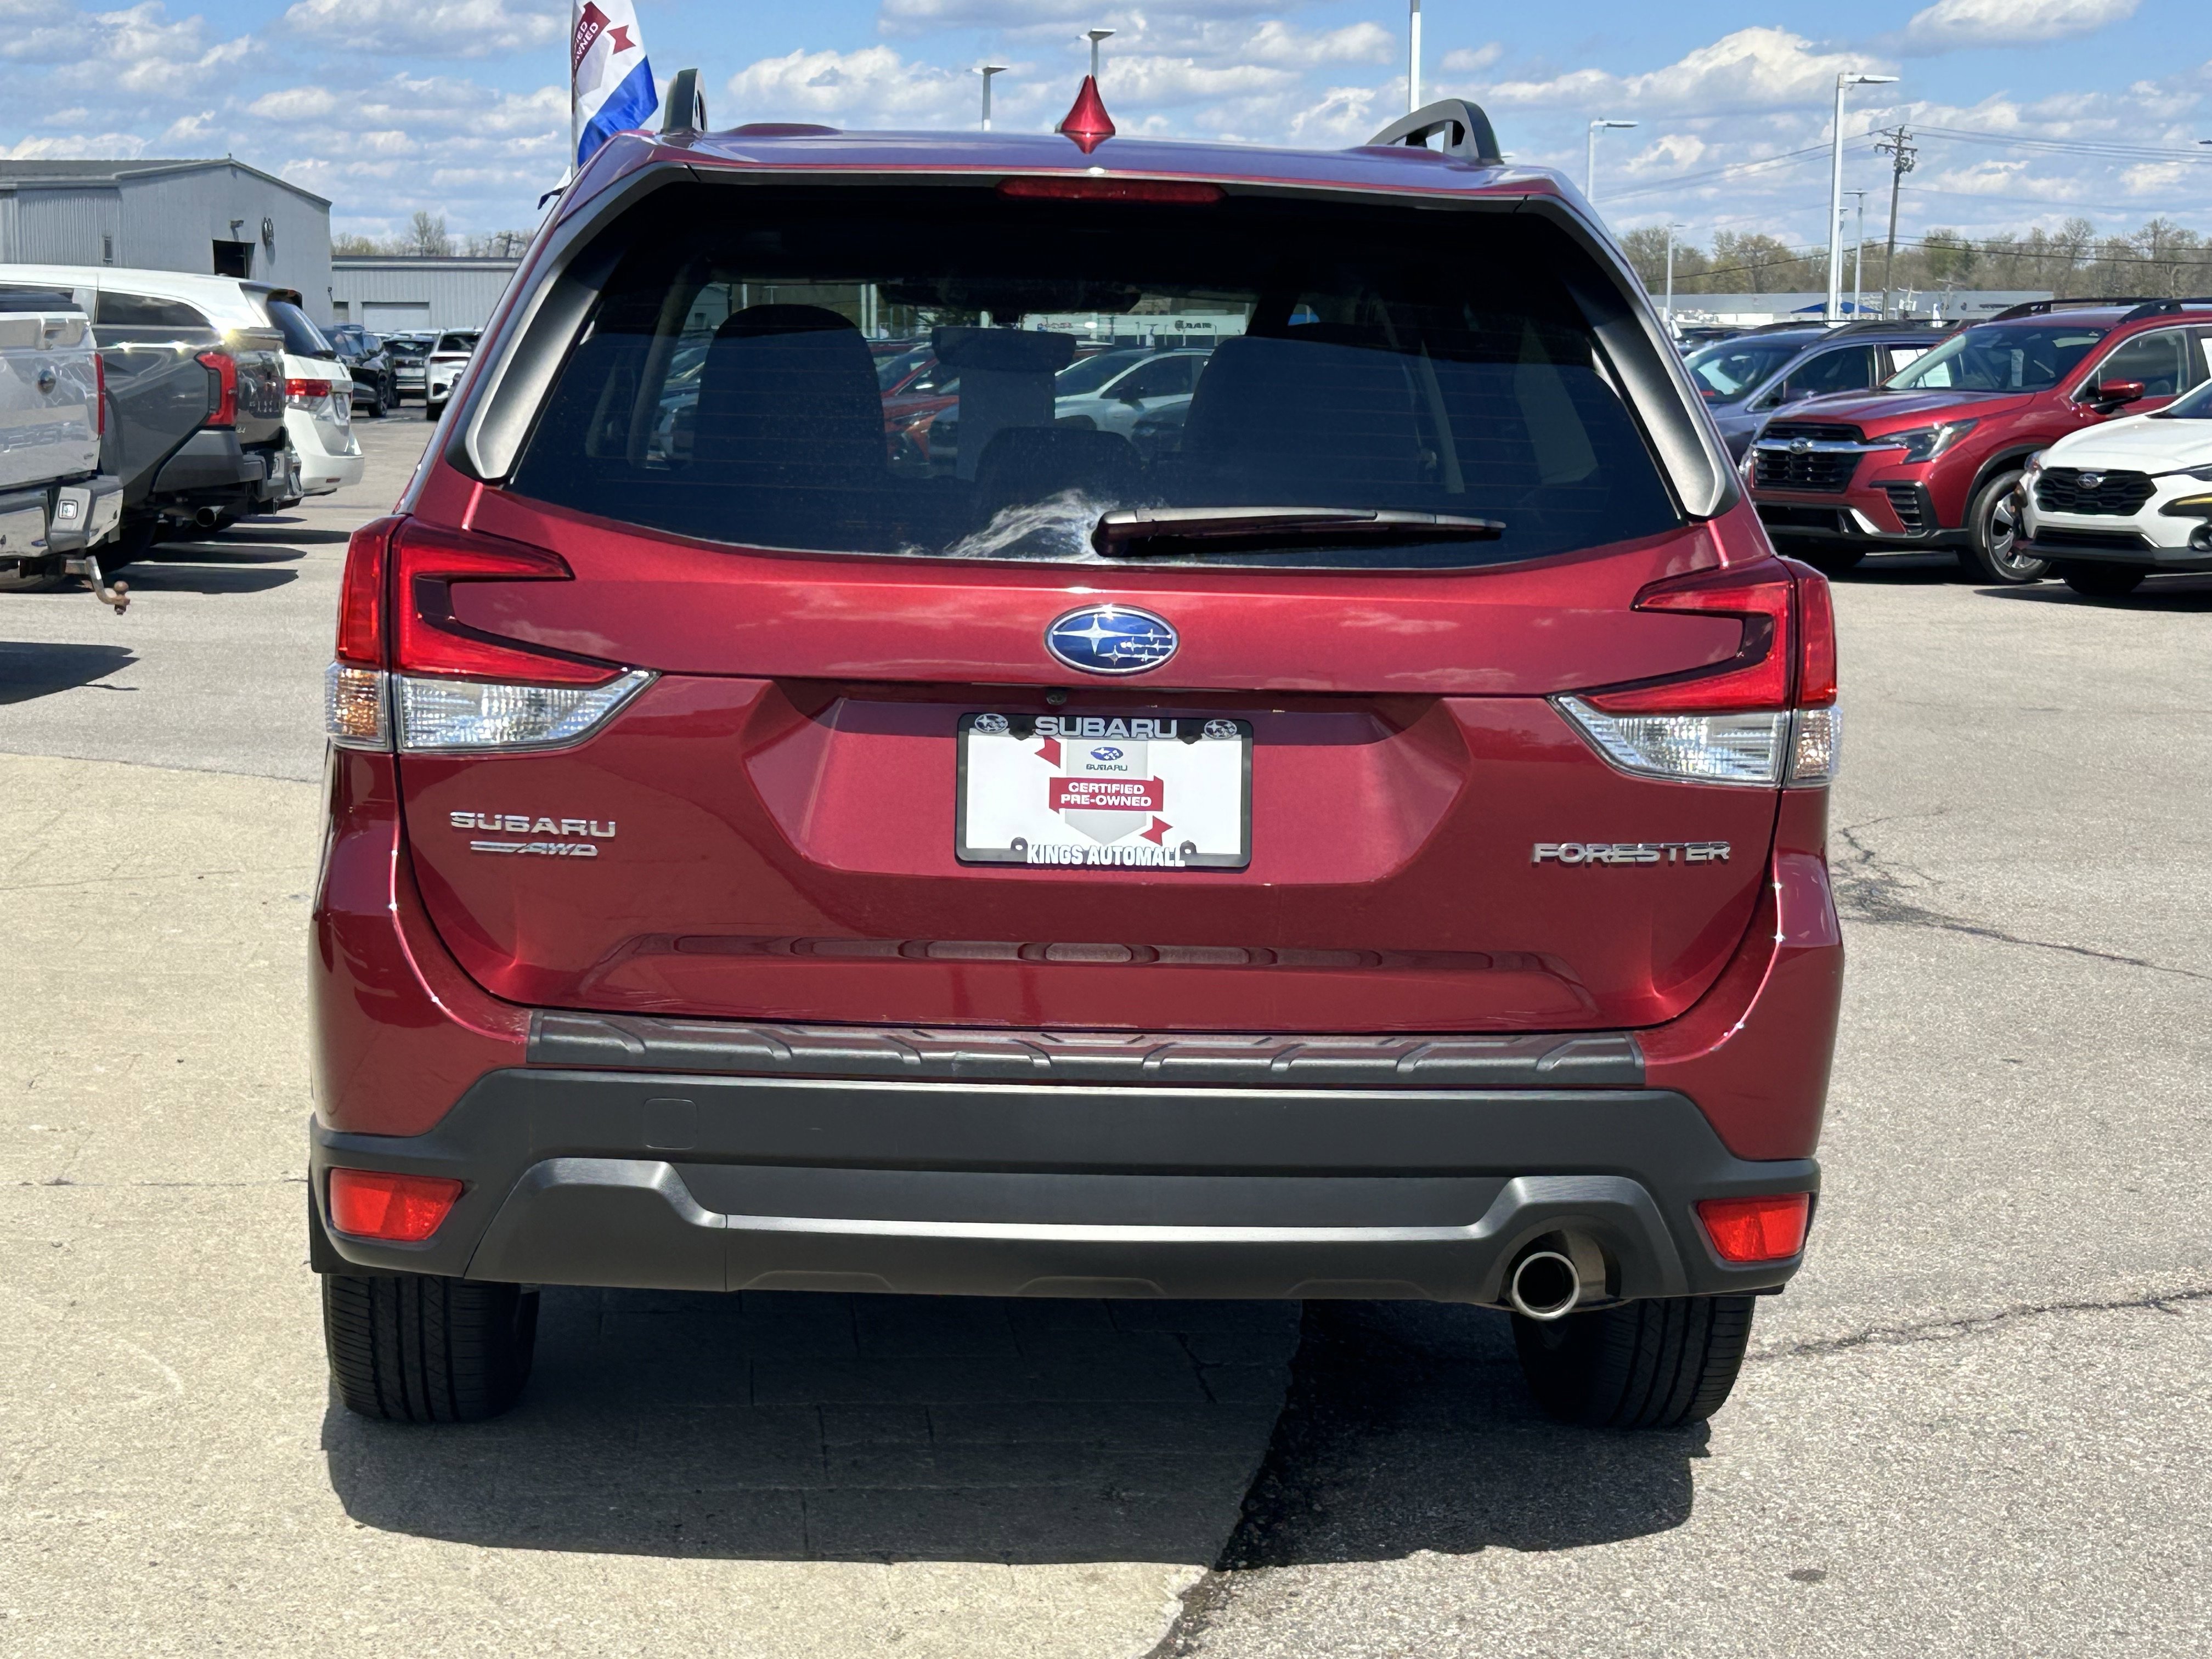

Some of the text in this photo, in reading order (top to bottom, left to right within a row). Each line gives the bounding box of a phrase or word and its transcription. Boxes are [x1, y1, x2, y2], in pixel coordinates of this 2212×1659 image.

[1035, 716, 1178, 738] SUBARU
[1068, 782, 1145, 795] CERTIFIED
[1060, 794, 1152, 807] PRE-OWNED
[449, 811, 616, 838] SUBARU
[517, 842, 599, 857] AWD
[1026, 844, 1186, 867] KINGS AUTOMALL
[1531, 840, 1731, 864] FORESTER
